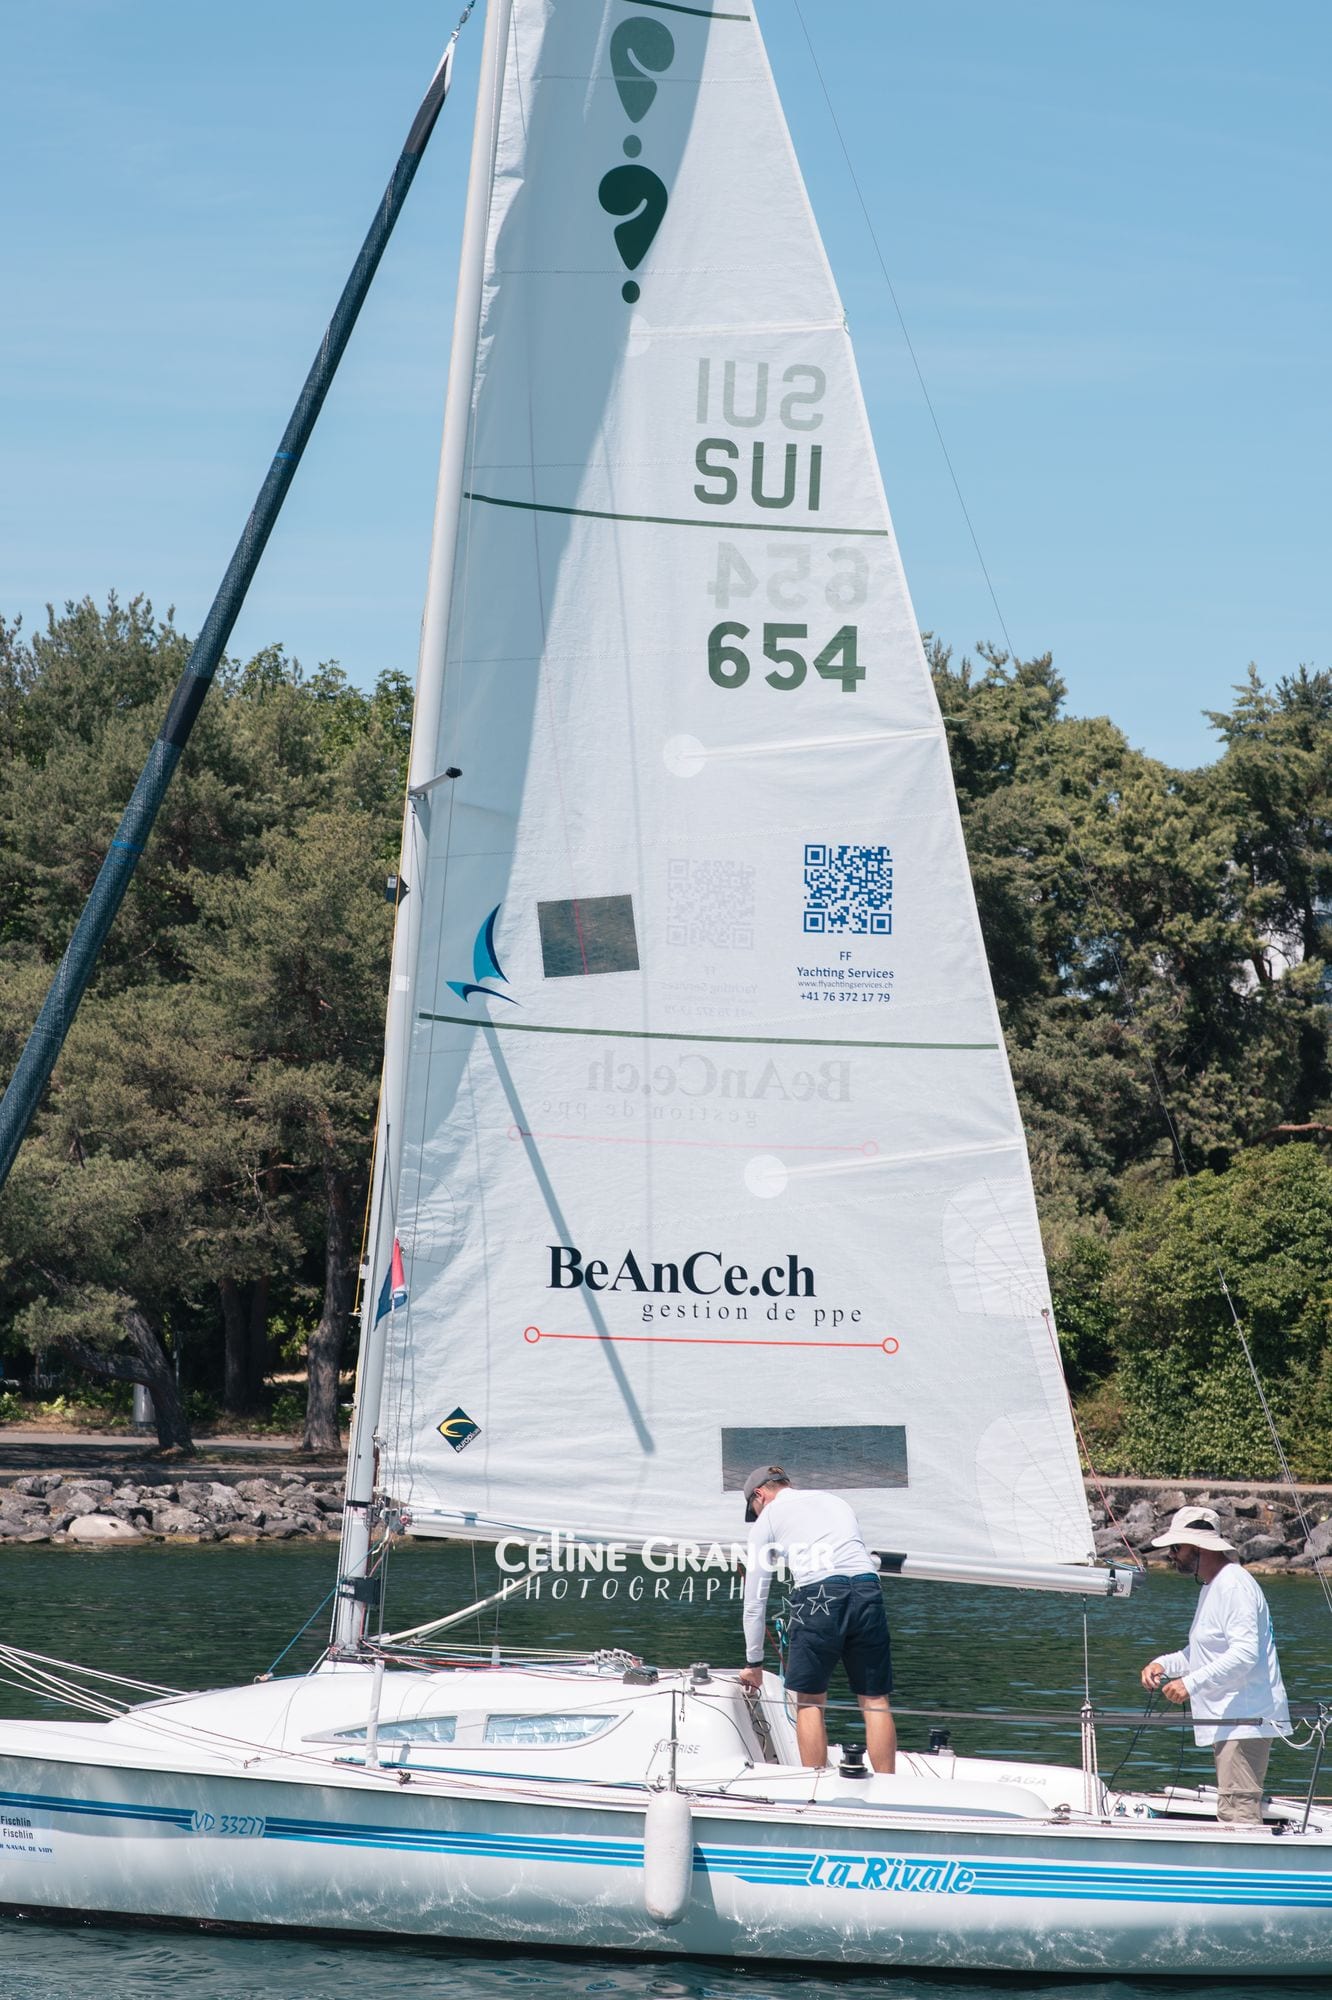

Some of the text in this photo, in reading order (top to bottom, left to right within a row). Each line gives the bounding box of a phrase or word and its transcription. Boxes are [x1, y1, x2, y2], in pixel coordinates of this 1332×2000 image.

[693, 437, 823, 511] SUI
[707, 621, 866, 693] 654
[839, 951, 852, 961] FF
[796, 966, 894, 980] Yachting Services
[797, 979, 893, 989] www.ffyachtingservices.ch
[800, 991, 890, 1003] +41 76 372 17 79
[545, 1245, 817, 1298] BeAnCe.ch
[641, 1300, 862, 1327] gestion de ppe
[653, 1744, 700, 1755] SURRISE
[0, 1815, 31, 1827] Fischlin
[194, 1810, 264, 1835] VD 33277
[3, 1828, 34, 1840] Fischlin
[808, 1855, 976, 1893] La Rivale
